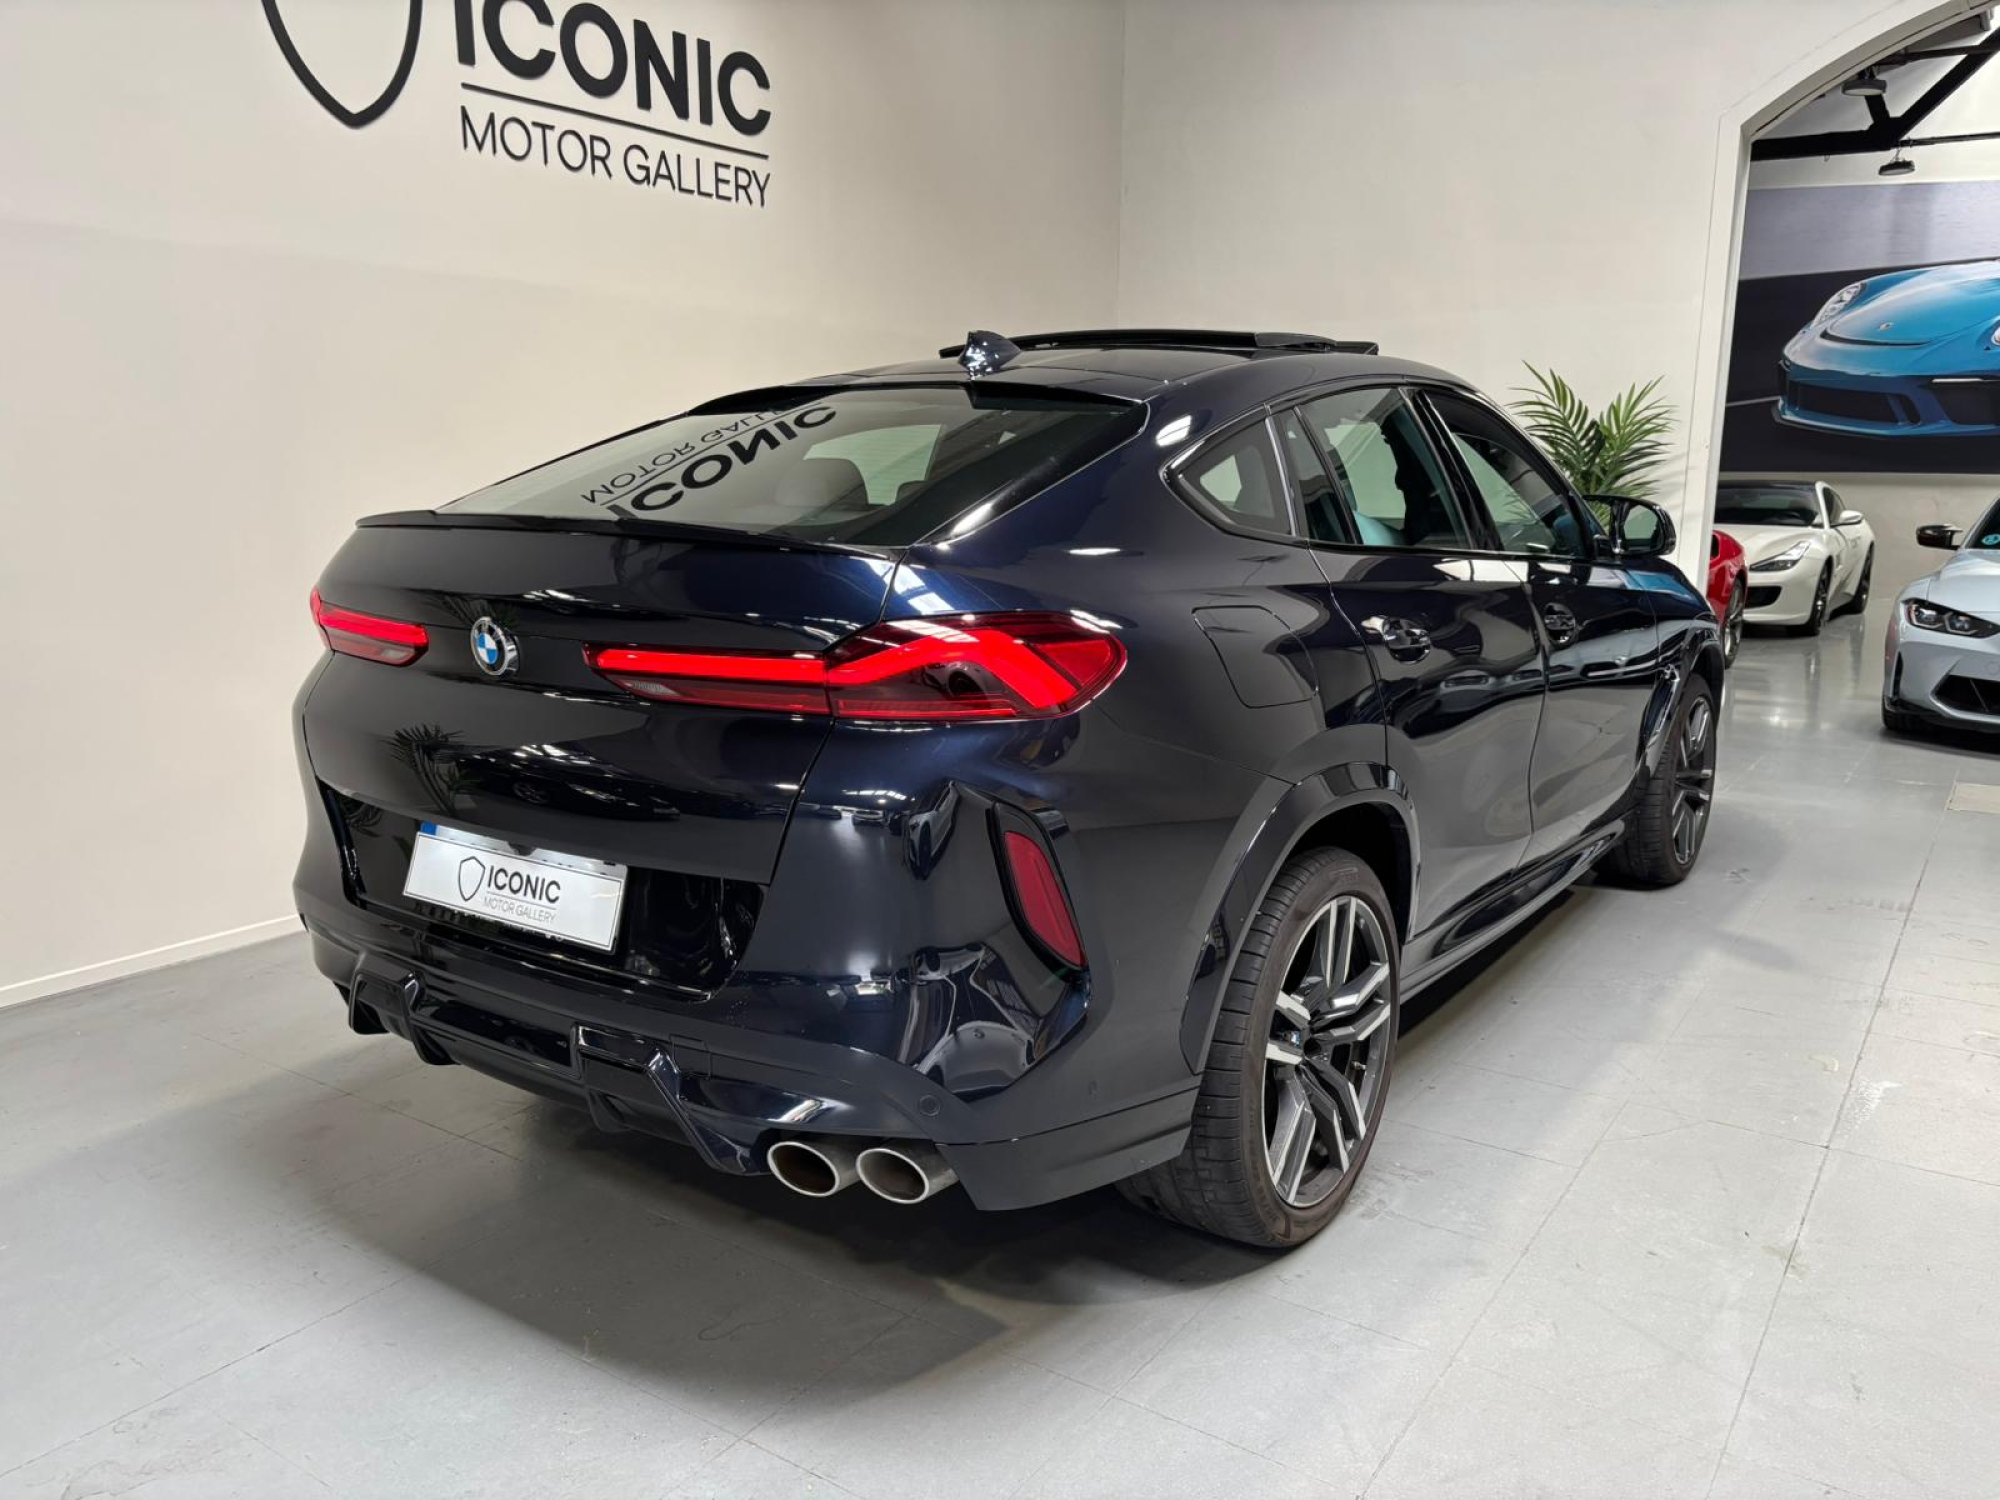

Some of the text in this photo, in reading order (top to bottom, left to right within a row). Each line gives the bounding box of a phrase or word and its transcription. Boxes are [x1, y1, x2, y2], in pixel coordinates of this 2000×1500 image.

[454, 0, 771, 136] ICONIC
[460, 105, 771, 208] MOTOR GALLERY
[483, 895, 557, 924] MOTOR GALLERY
[487, 865, 561, 903] ICONIC
